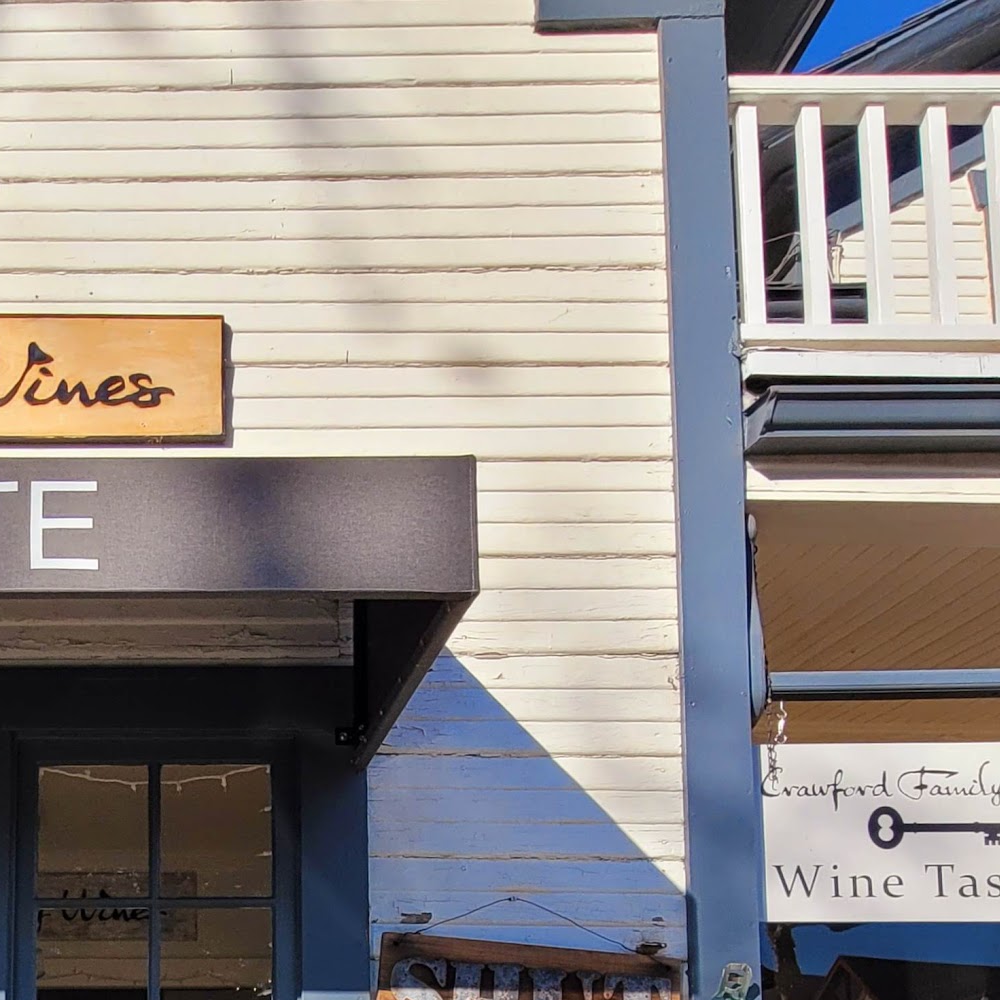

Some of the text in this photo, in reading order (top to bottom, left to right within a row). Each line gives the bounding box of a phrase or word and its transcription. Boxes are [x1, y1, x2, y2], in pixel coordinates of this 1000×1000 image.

[761, 761, 1000, 811] Crawford Family
[772, 864, 1000, 898] Wine Tas
